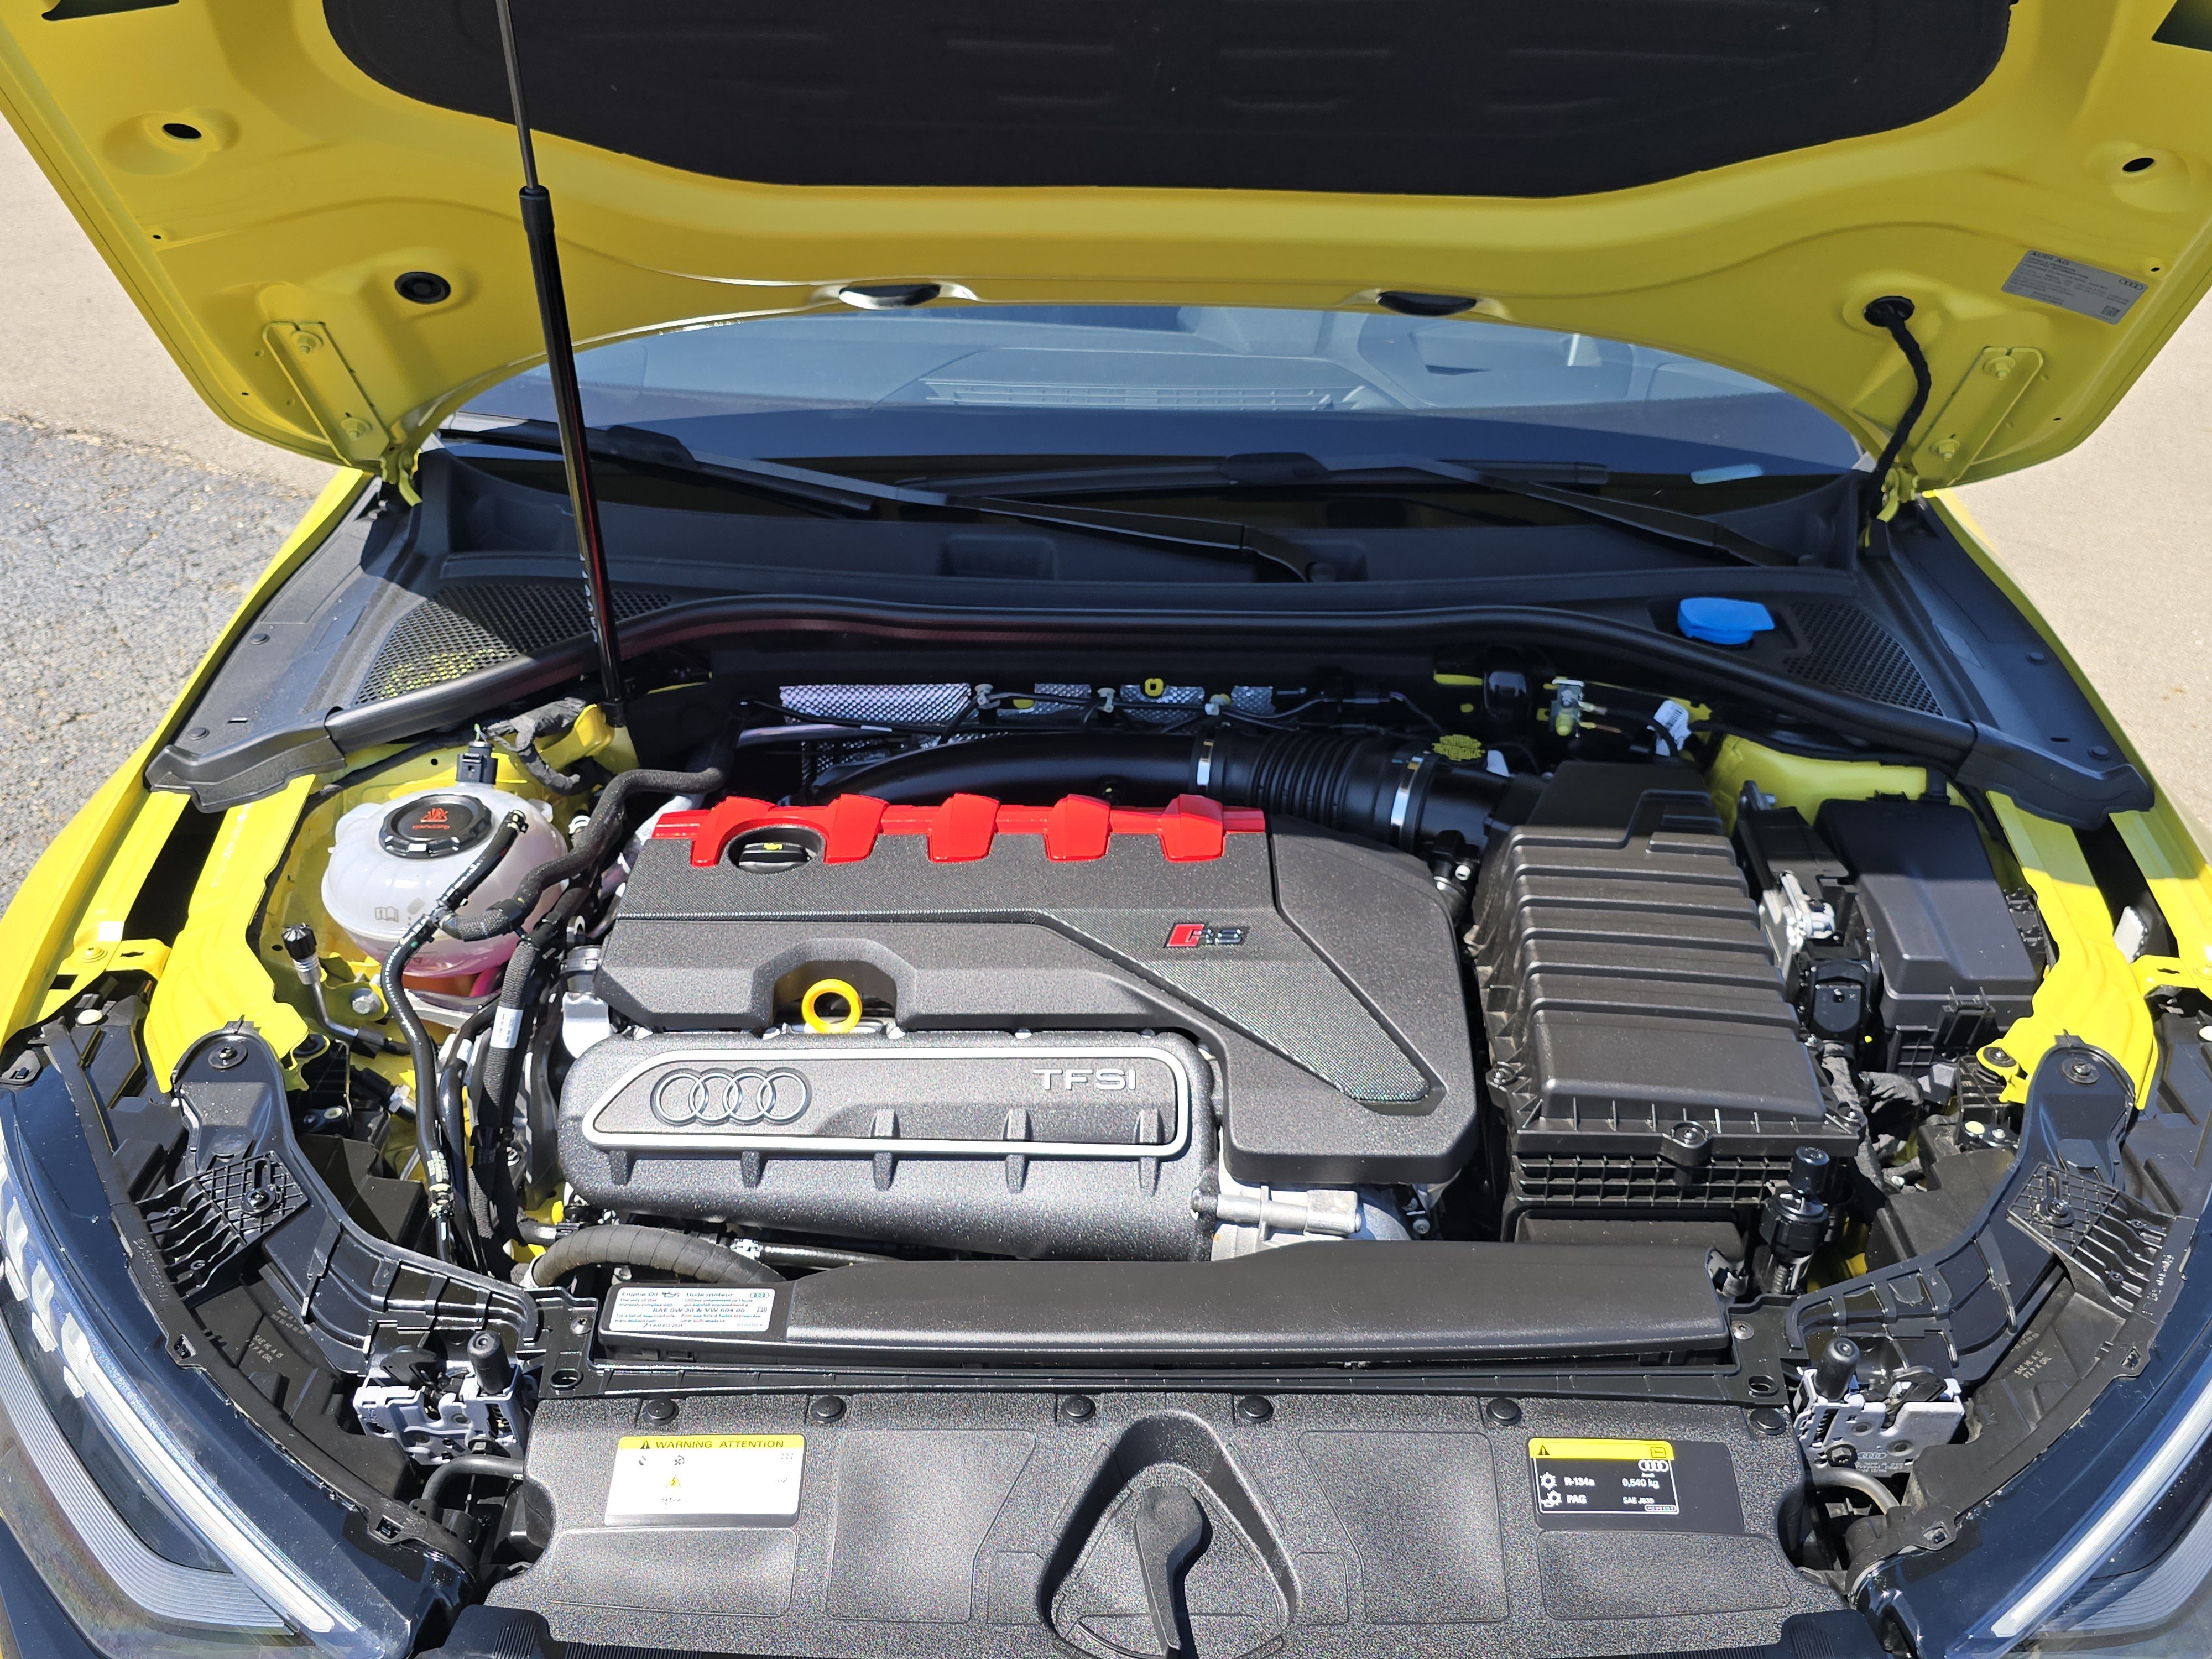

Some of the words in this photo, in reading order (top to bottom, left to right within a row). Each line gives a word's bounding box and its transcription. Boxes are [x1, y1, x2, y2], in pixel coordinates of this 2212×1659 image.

[1033, 1068, 1136, 1091] TFSI
[253, 1335, 267, 1345] SAE
[2013, 1364, 2027, 1375] SAE
[655, 1440, 712, 1448] WARNING
[719, 1440, 784, 1448] ATTENTION
[1564, 1477, 1595, 1487] R-134a
[1647, 1478, 1660, 1489] kg
[1566, 1494, 1587, 1504] PAG
